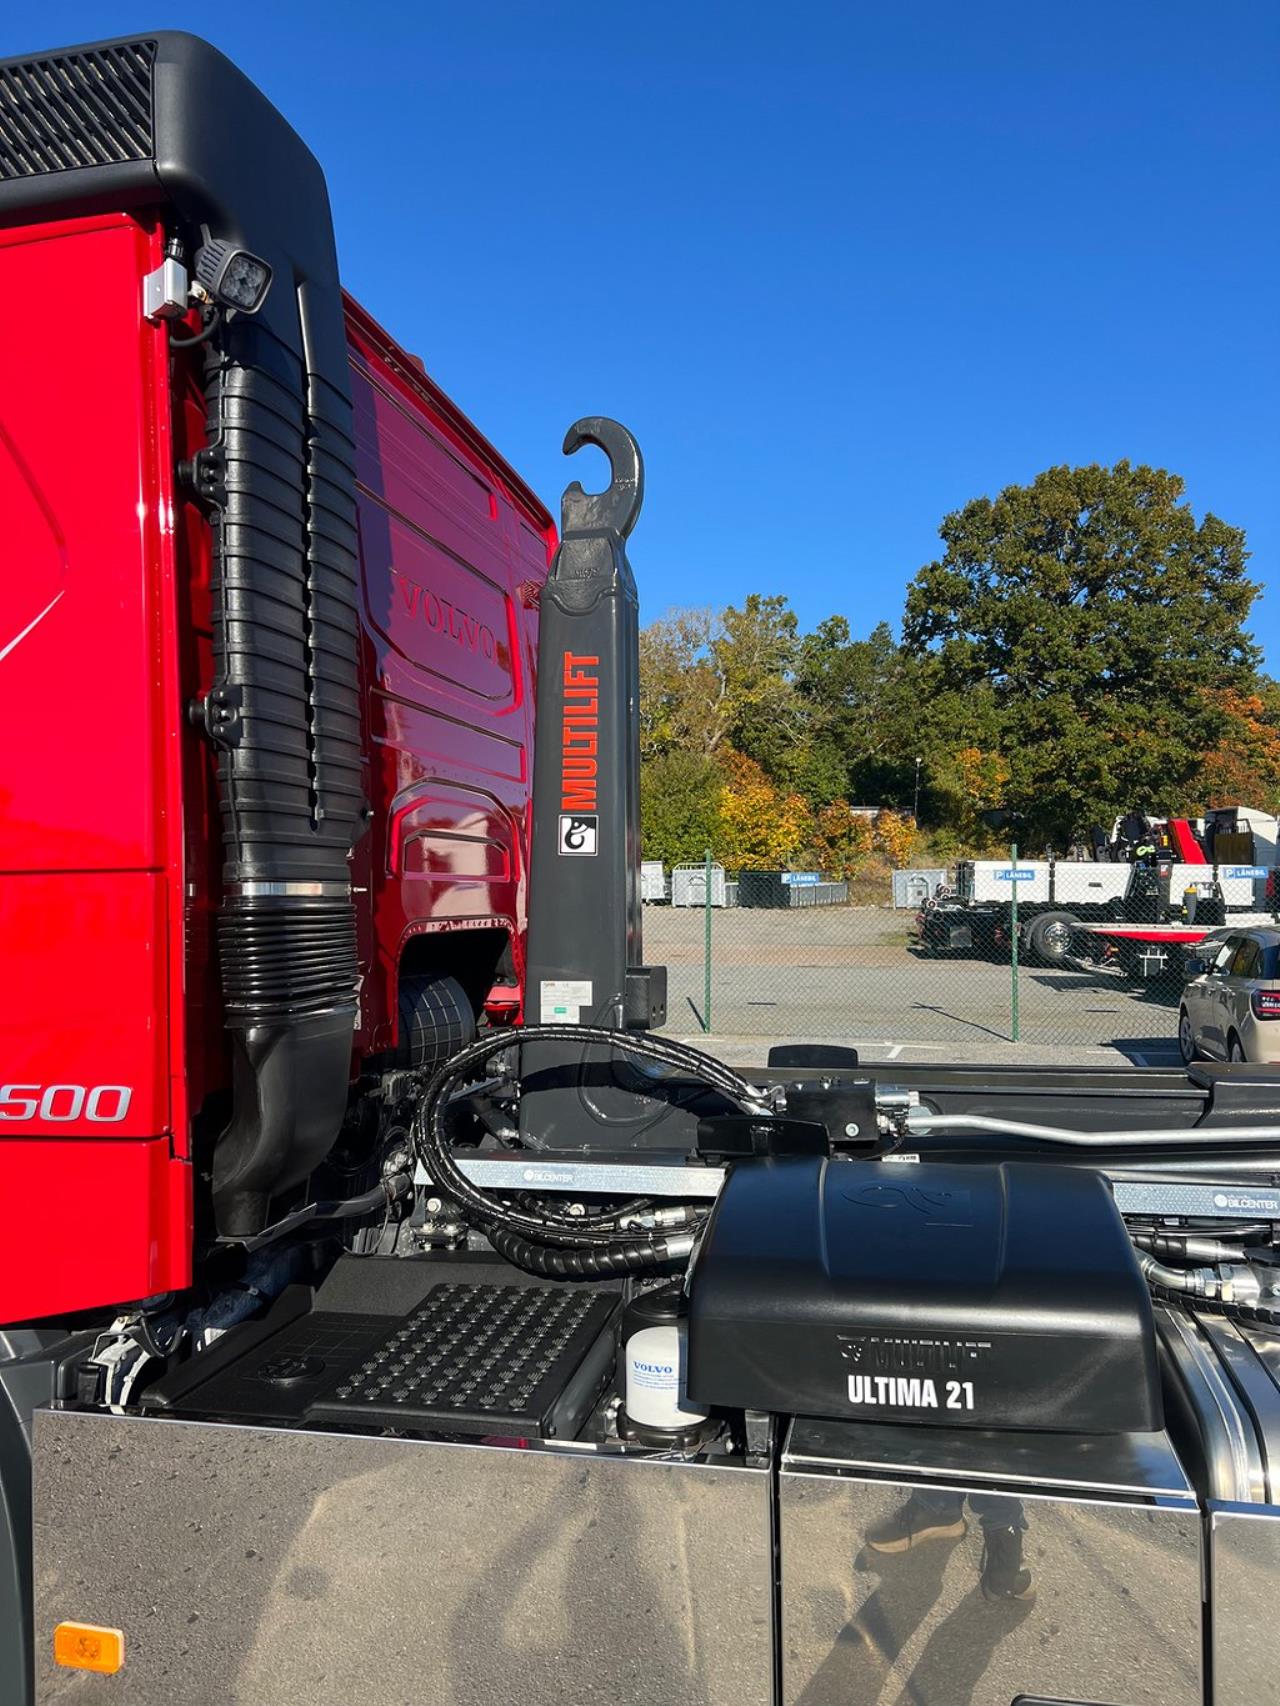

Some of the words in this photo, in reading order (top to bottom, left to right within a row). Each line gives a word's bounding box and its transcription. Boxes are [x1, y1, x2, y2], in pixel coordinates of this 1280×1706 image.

[398, 577, 498, 665] VOLVO
[561, 651, 600, 810] MULTILIFT
[793, 873, 817, 881] LÅNEBIL
[1005, 870, 1032, 879] LÅNEBIL
[1237, 868, 1266, 876] LÅNEBIL
[0, 1084, 133, 1122] 500
[1229, 1199, 1279, 1210] BILCENTER
[633, 1361, 673, 1374] VOLVO
[848, 1374, 939, 1408] ULTIMA
[945, 1380, 975, 1410] 21
